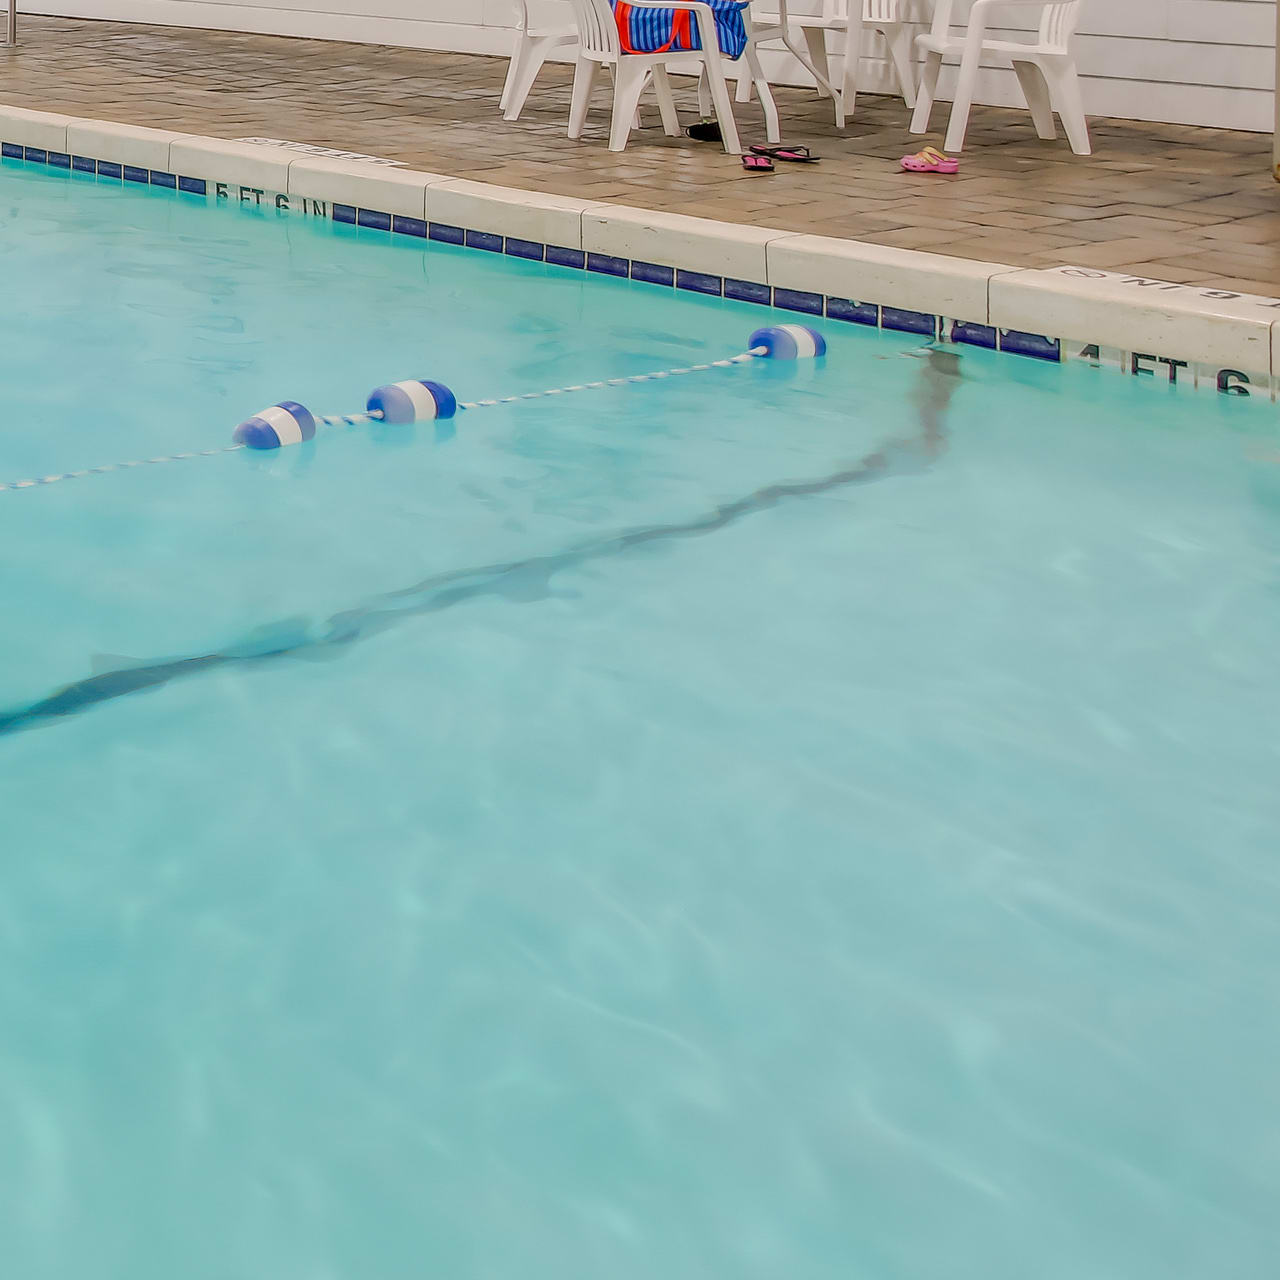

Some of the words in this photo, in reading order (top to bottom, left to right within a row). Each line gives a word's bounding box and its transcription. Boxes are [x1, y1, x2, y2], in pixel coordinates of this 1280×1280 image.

[215, 182, 228, 199] 5
[239, 185, 265, 205] FT
[303, 198, 327, 218] IN
[1131, 351, 1188, 385] FT
[1216, 368, 1251, 398] 6
